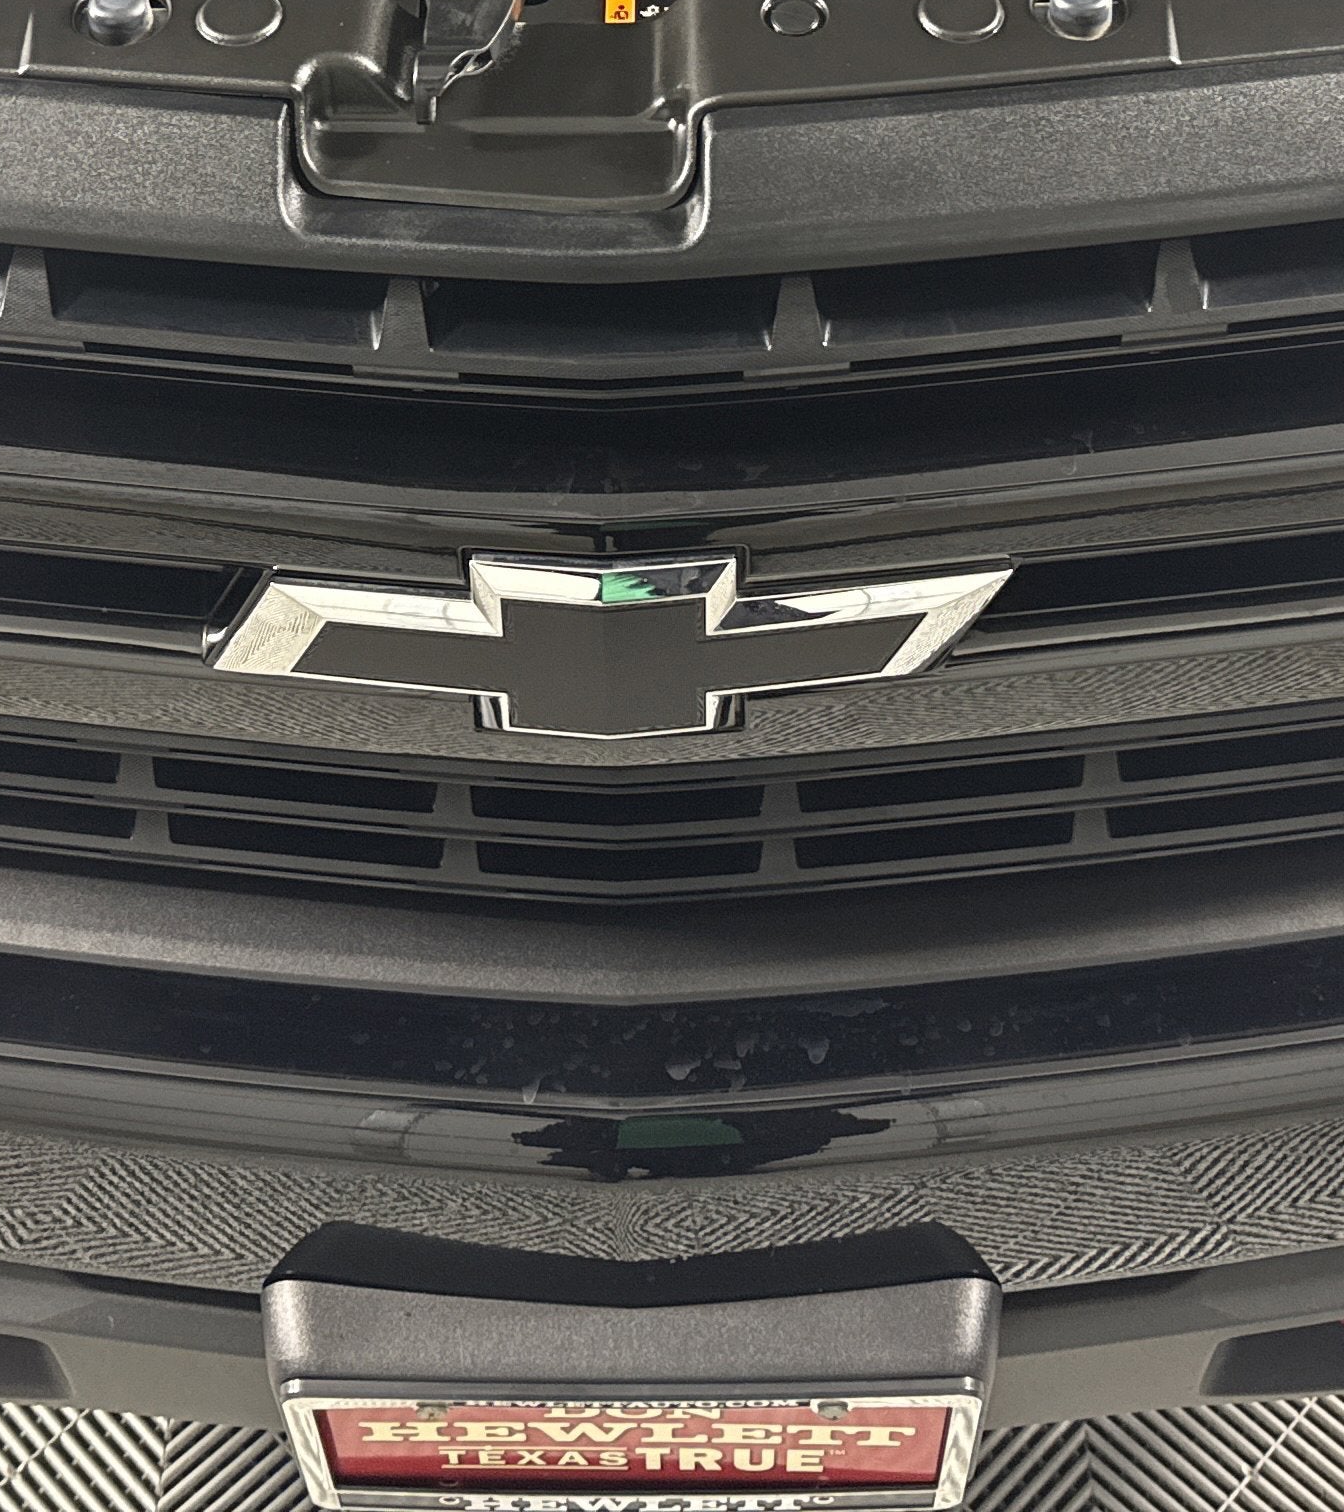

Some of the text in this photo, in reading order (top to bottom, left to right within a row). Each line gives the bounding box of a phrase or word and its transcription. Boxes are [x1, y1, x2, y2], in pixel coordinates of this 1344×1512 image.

[357, 1420, 916, 1447] HEWLETT
[439, 1448, 629, 1466] TEXAS
[635, 1447, 825, 1473] TRUE
[460, 1494, 811, 1512] HEWLETT
